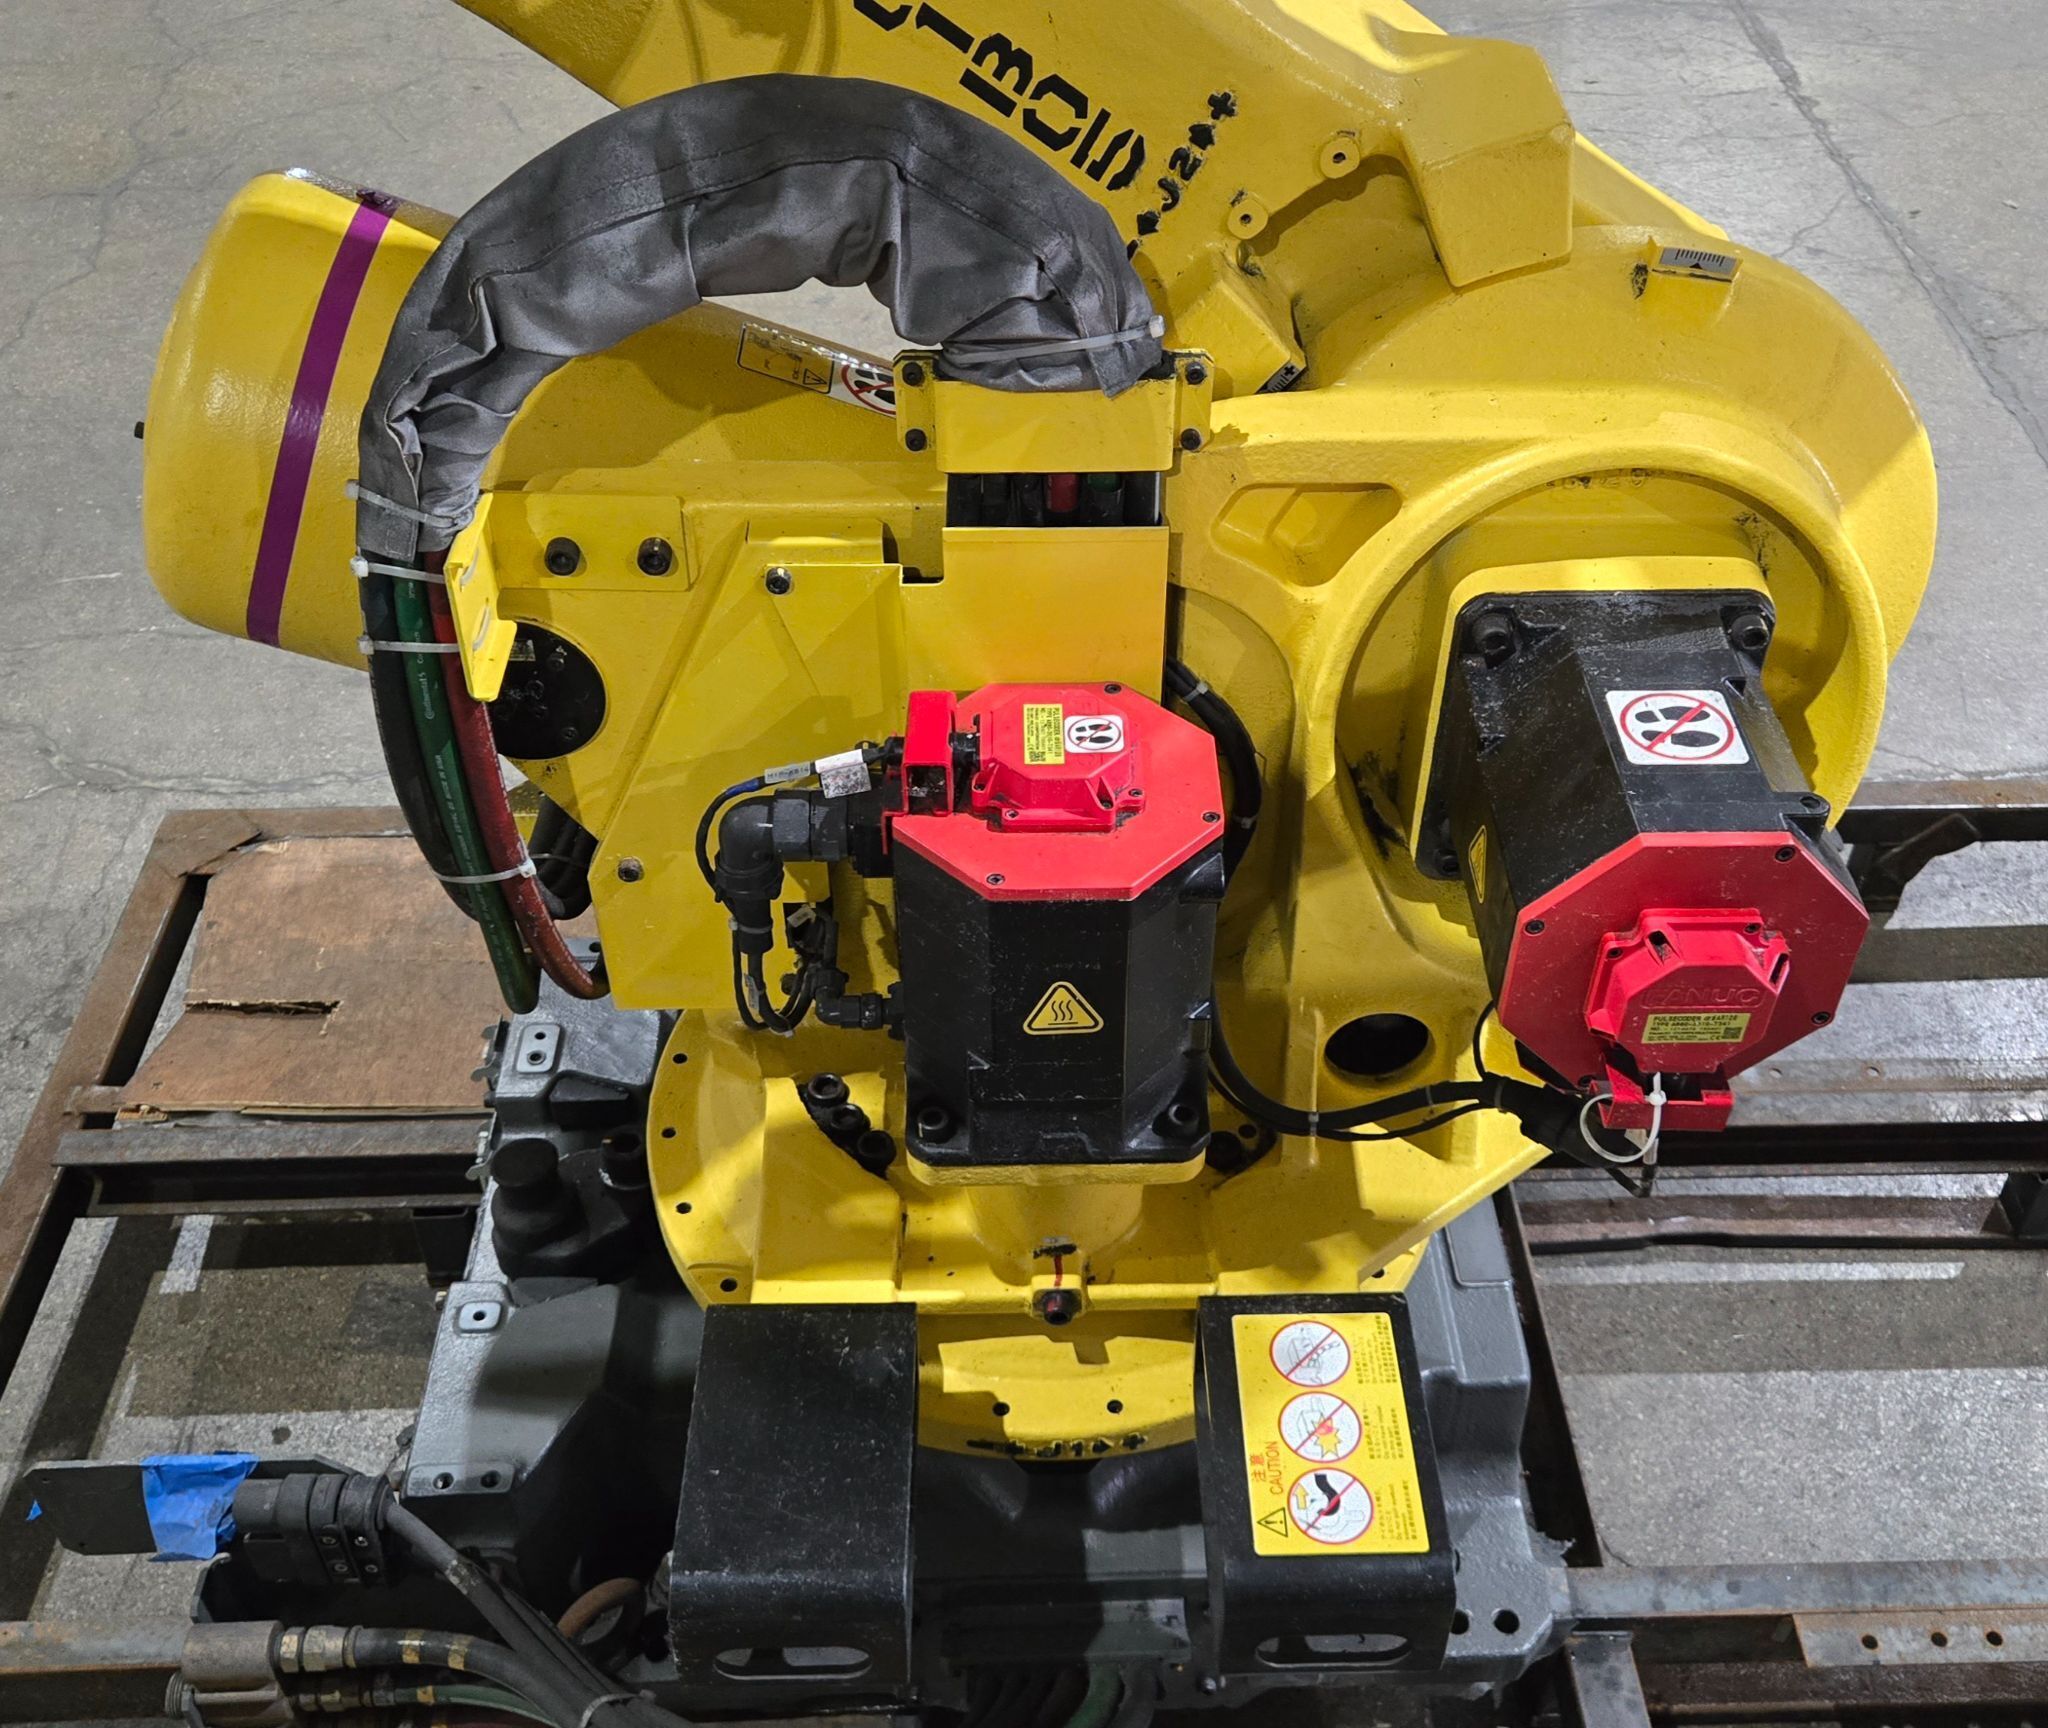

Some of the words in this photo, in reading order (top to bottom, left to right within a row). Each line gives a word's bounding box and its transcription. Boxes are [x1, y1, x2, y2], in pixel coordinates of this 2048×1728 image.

[1157, 146, 1202, 212] J2
[1249, 1454, 1267, 1483] 注意
[1268, 1440, 1285, 1495] CAUTION
